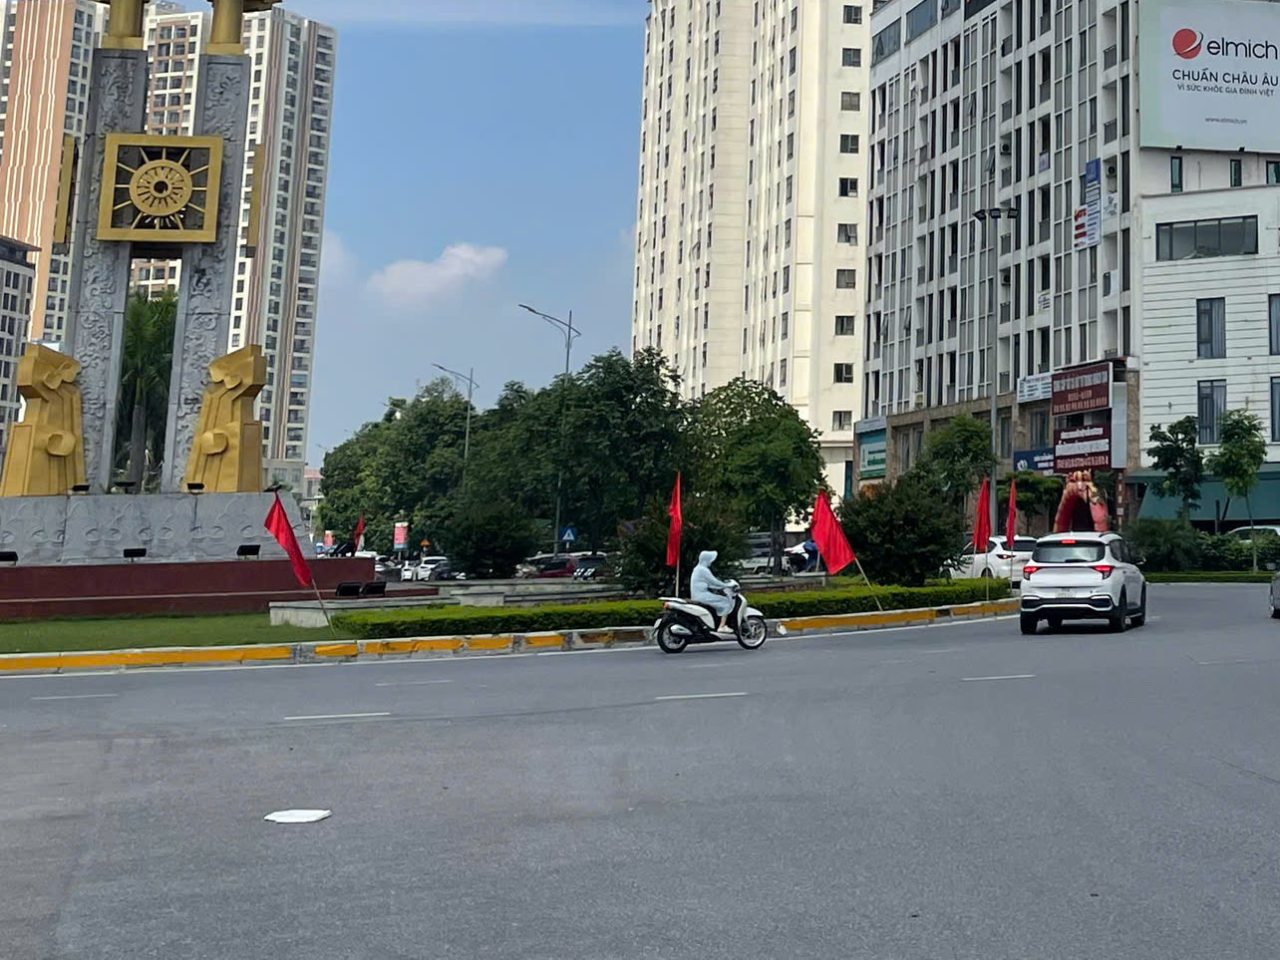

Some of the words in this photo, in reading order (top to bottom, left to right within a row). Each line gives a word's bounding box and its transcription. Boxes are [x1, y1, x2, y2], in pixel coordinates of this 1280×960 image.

[1206, 37, 1278, 60] elmich
[1222, 71, 1258, 86] CHÂU
[1261, 72, 1279, 87] ÂU
